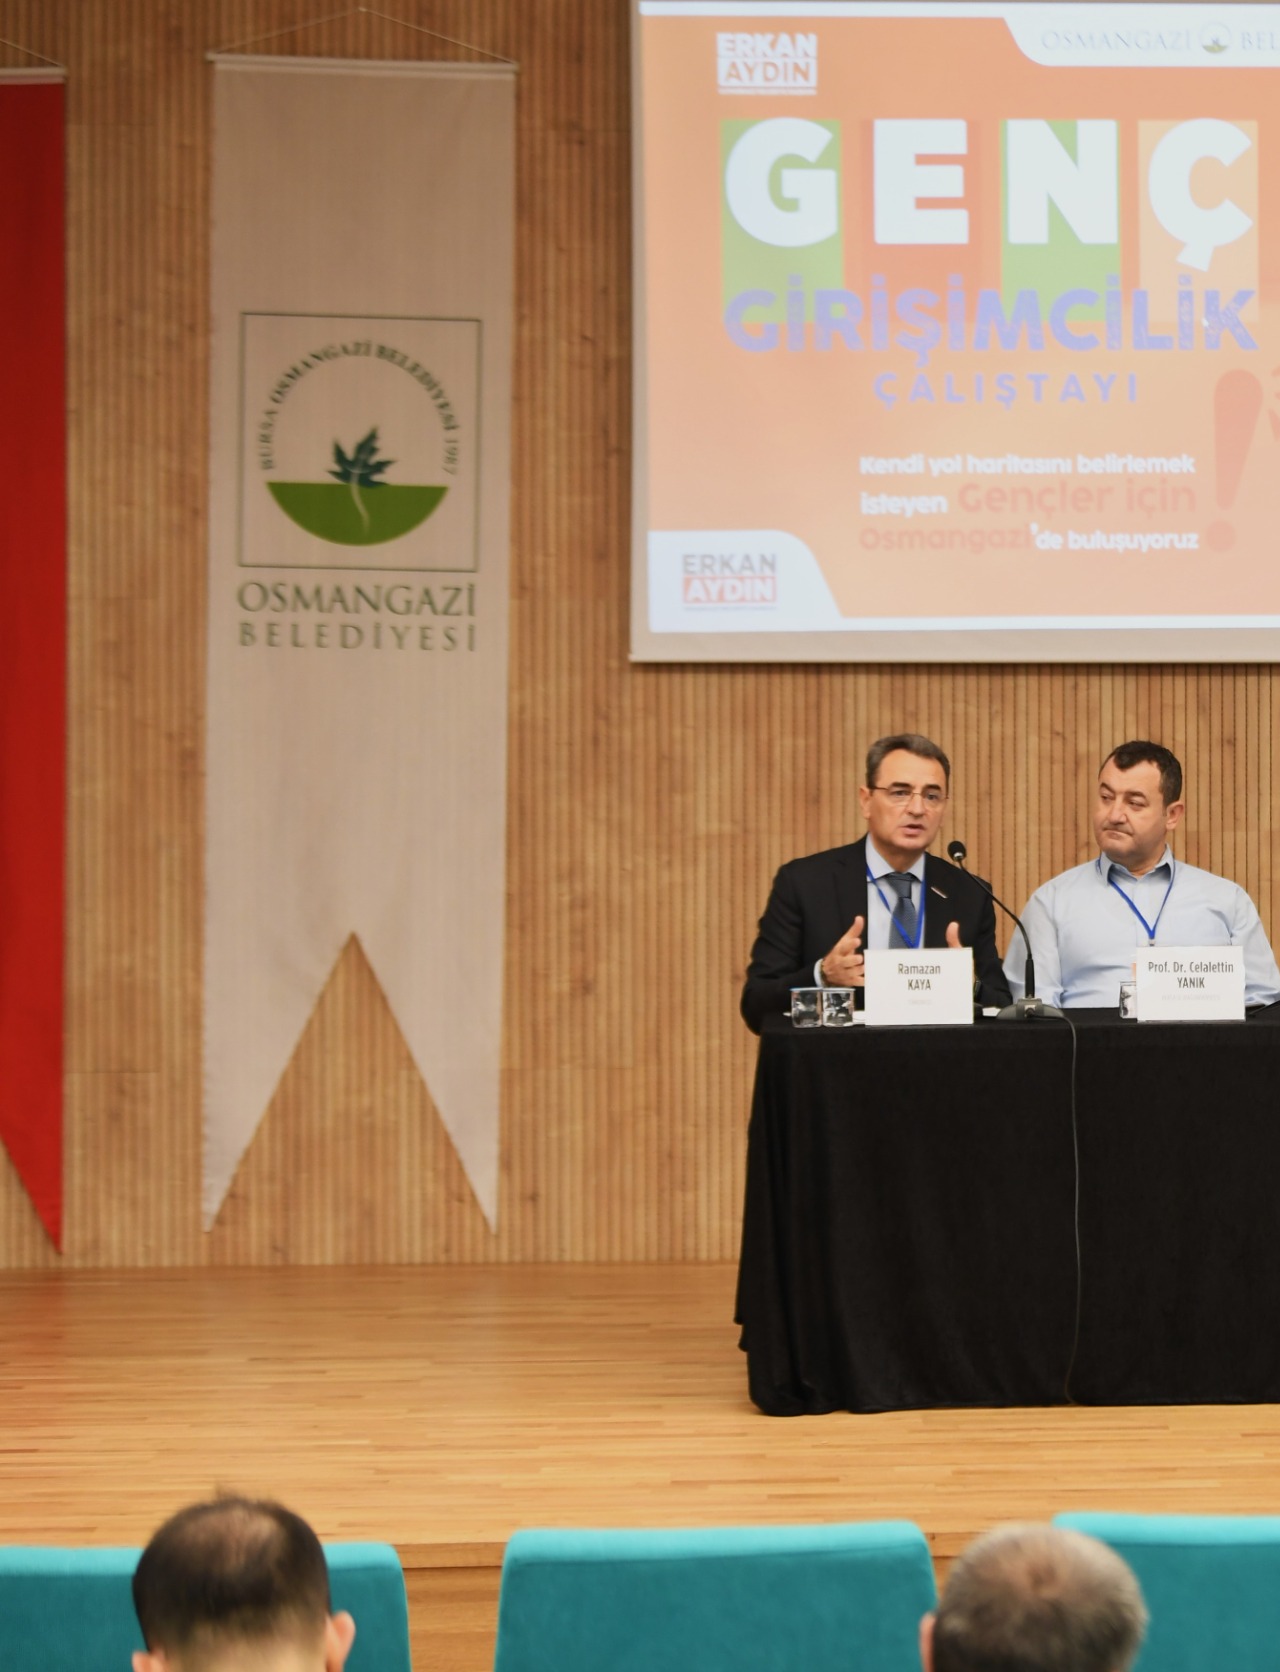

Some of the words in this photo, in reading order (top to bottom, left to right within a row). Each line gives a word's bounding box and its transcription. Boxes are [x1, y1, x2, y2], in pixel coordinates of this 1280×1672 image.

[716, 32, 817, 58] ERKAN
[1041, 29, 1191, 50] OSMANGAZİ
[724, 61, 810, 82] AYDIN
[724, 116, 1255, 272] GENÇ
[723, 273, 1260, 368] GİRİŞİMCİLİK
[872, 372, 1138, 409] ÇALIŞTAYI
[859, 453, 925, 474] Kendi
[928, 453, 962, 477] yol
[967, 453, 1073, 474] haritasını
[1077, 453, 1197, 474] belirlemek
[860, 492, 948, 518] isteyen
[957, 479, 1114, 518] Gençler
[1125, 477, 1197, 519] için
[1068, 530, 1200, 553] buluşuyoruz
[683, 554, 777, 574] ERKAN
[237, 581, 476, 617] OSMANGAZİ
[686, 577, 775, 602] AYDIN
[239, 621, 476, 652] BELEDİYESİ
[898, 963, 941, 975] Ramazan
[1148, 961, 1170, 973] Prof.
[1173, 961, 1187, 973] Dr.
[1189, 961, 1234, 973] Celalettin
[907, 979, 931, 991] KAYA
[1177, 977, 1205, 989] YANIK
